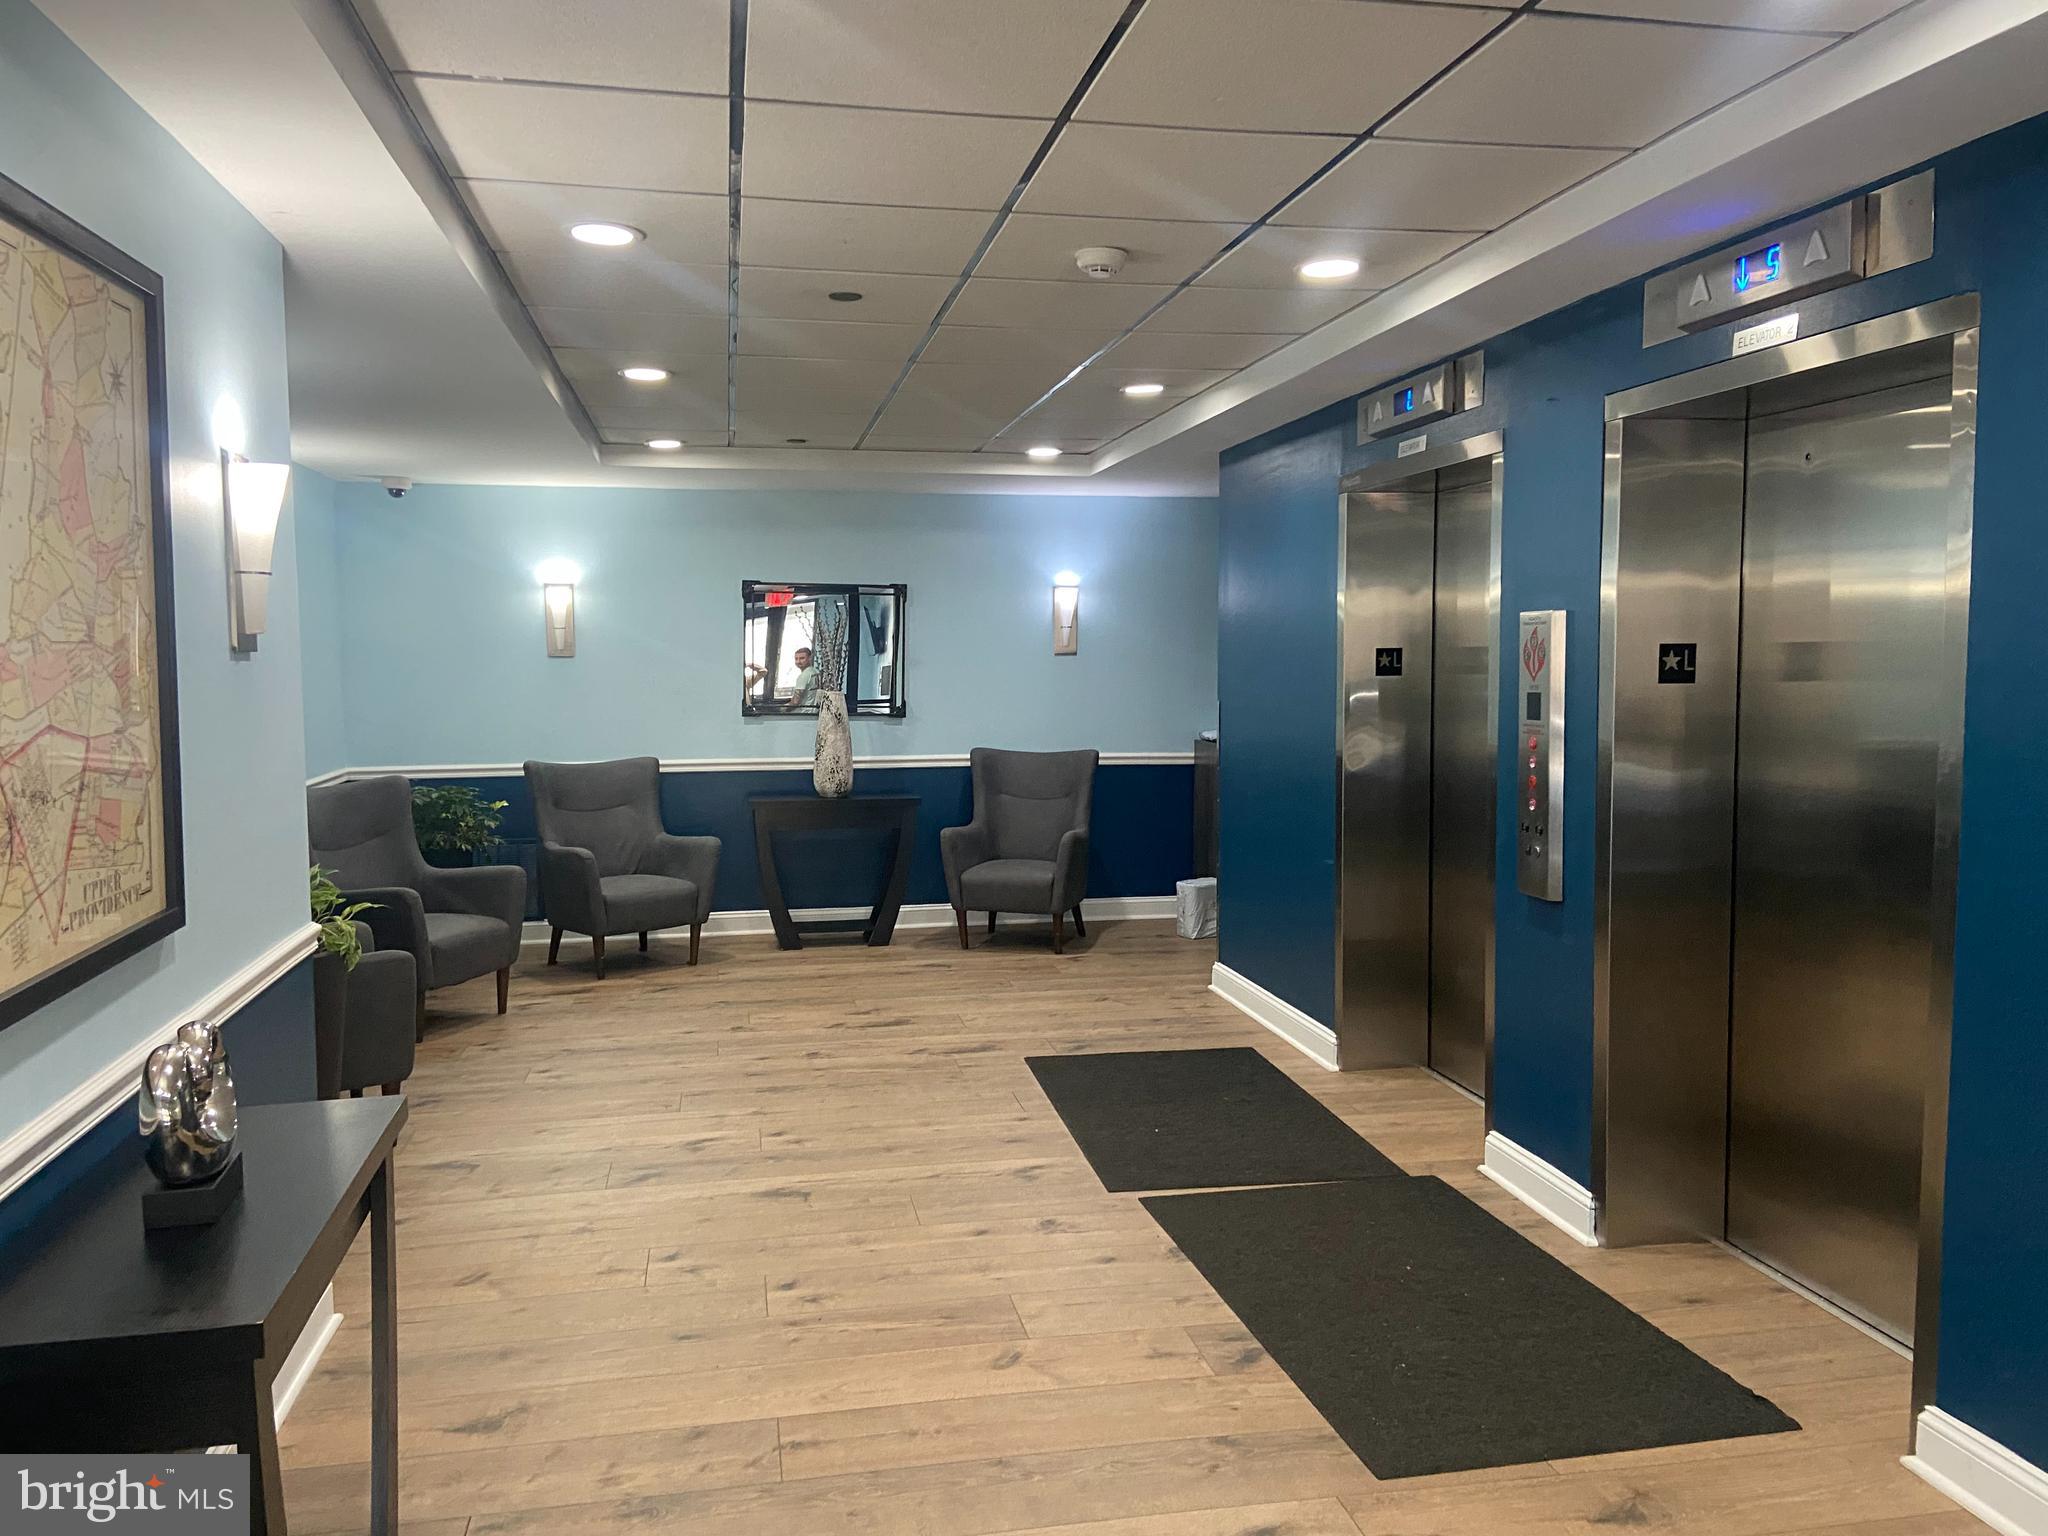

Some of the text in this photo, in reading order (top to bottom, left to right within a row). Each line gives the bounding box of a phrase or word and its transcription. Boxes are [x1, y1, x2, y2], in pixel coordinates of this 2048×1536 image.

[1738, 326, 1781, 349] ELEVATOR
[1393, 651, 1401, 667] L
[1684, 649, 1695, 670] L
[83, 869, 122, 903] UPPER
[68, 883, 142, 931] PROVIDENCE
